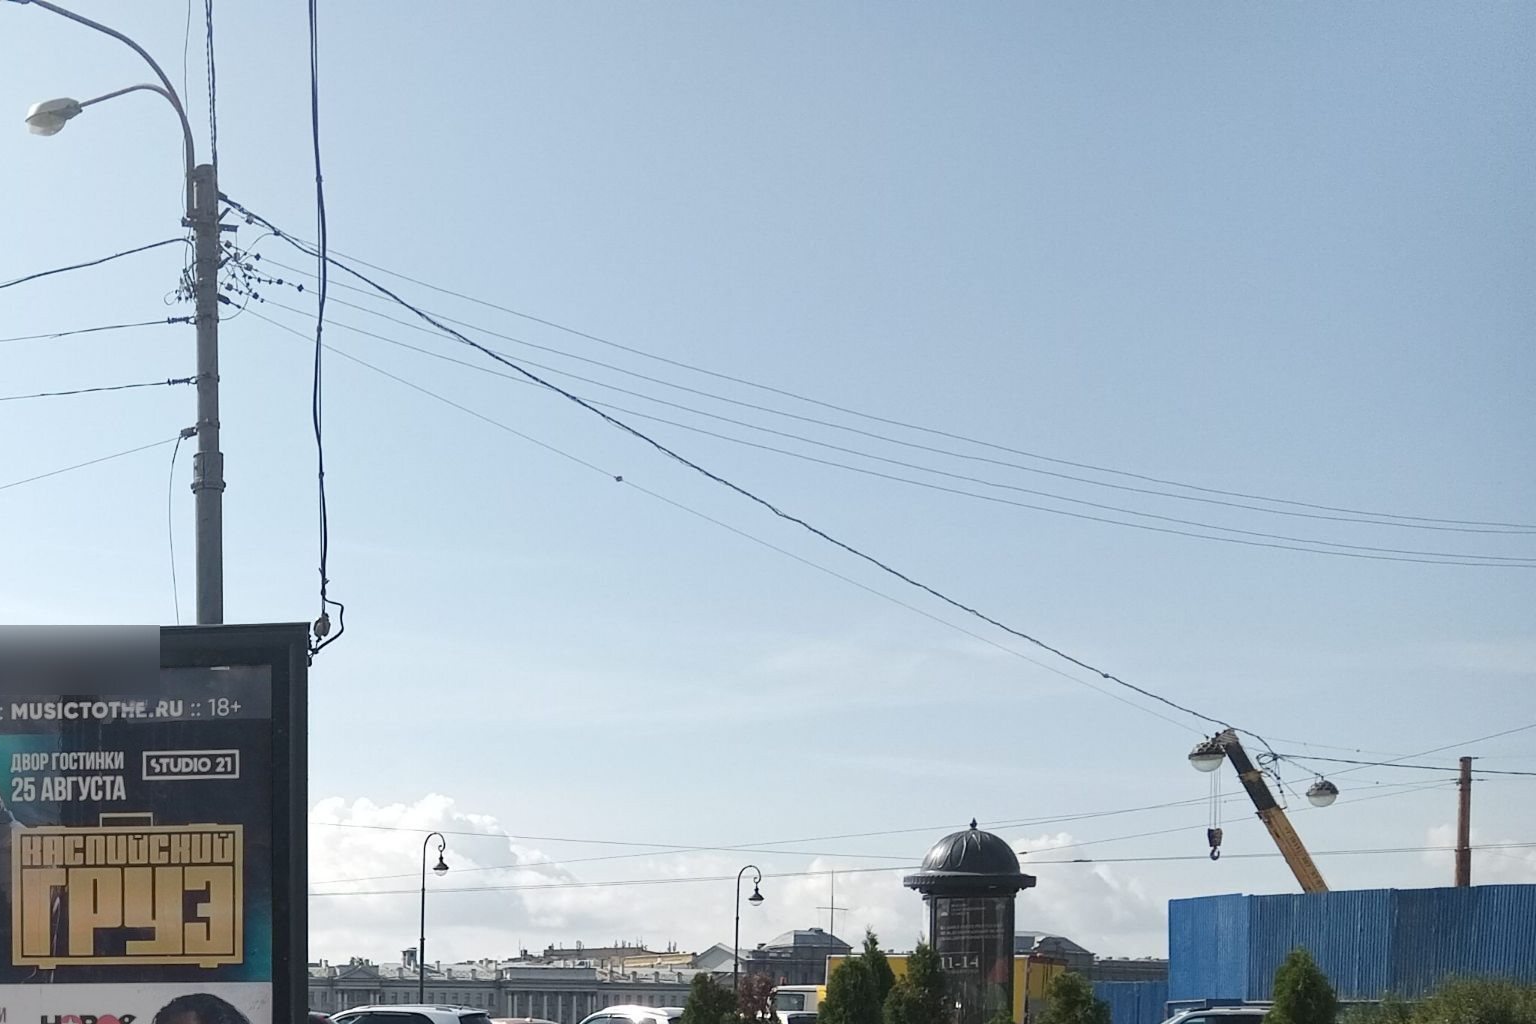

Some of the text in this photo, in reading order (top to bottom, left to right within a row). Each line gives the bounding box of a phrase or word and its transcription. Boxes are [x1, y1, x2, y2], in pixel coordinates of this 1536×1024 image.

[11, 700, 183, 720] MUSICTOTHE.RU
[208, 697, 242, 717] 18+
[10, 751, 124, 773] ДВОР ГОСТИНКИ
[150, 757, 232, 773] STUDIO 21
[11, 775, 127, 801] 25 АВГУСТА
[21, 832, 234, 866] КАСПИЙСКИЙ
[22, 866, 234, 956] ГРУЗ
